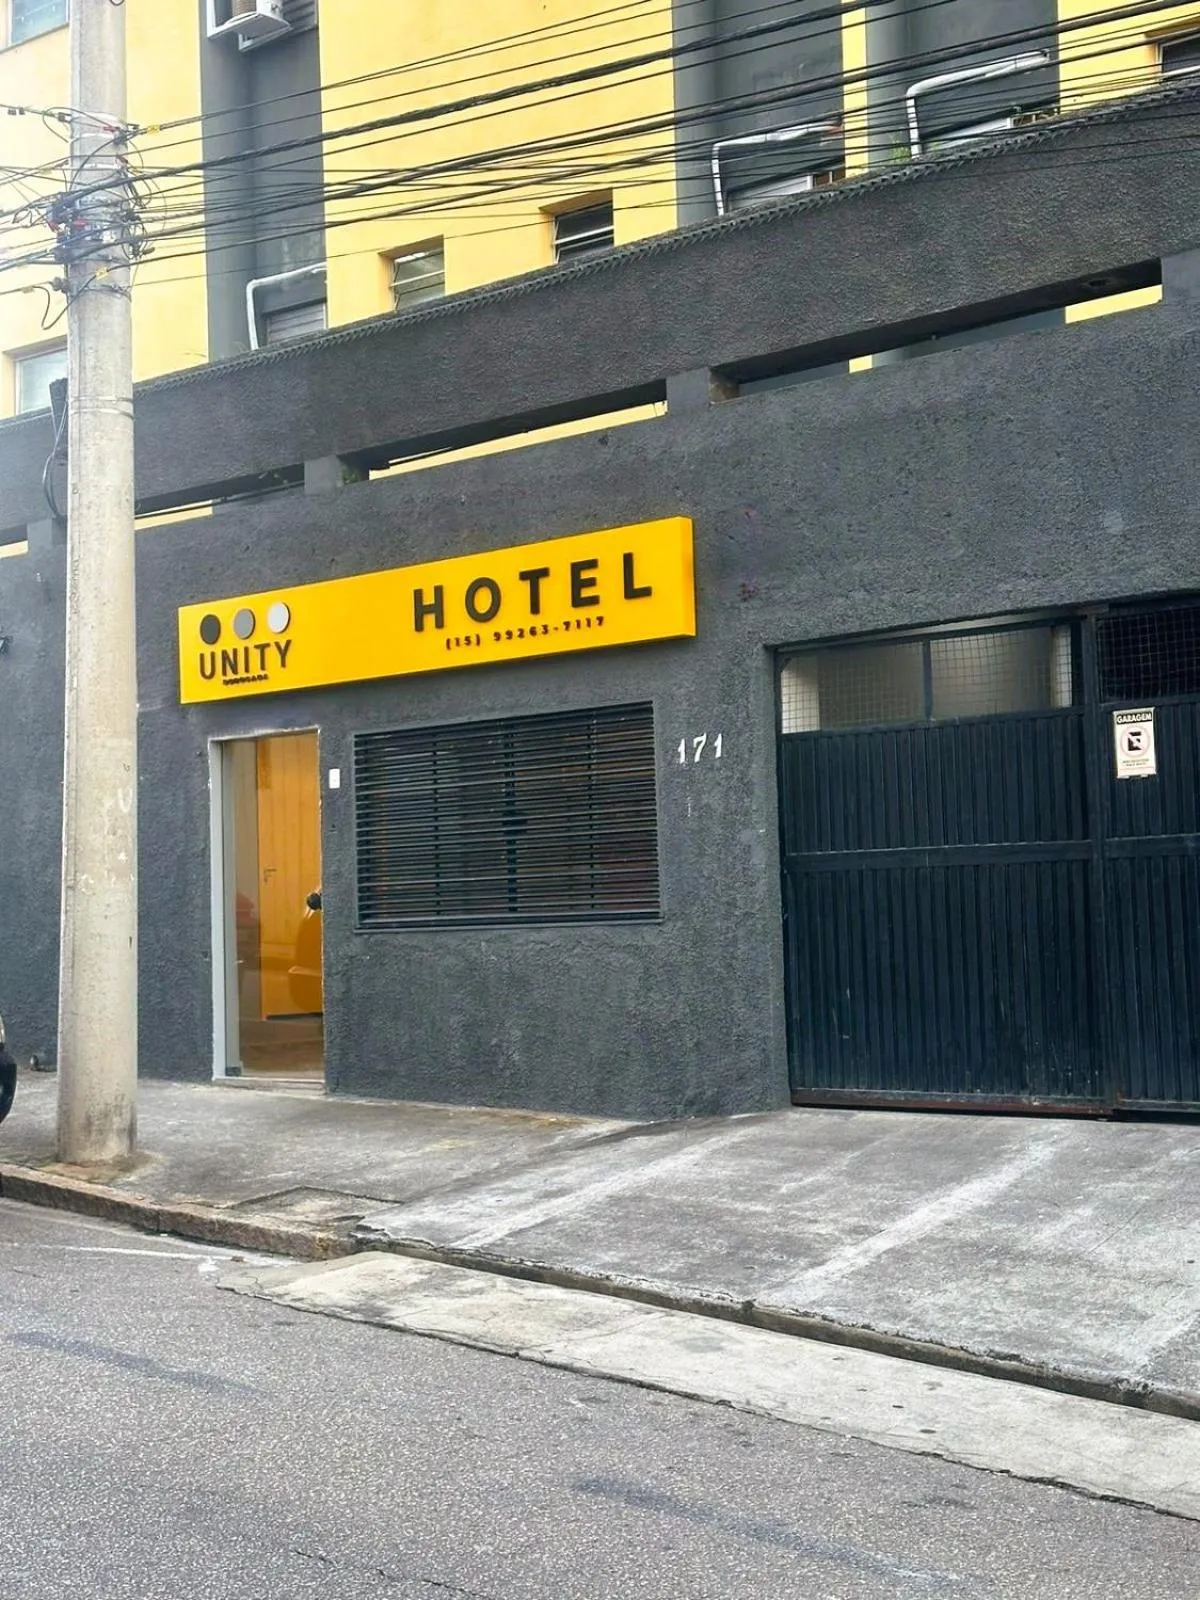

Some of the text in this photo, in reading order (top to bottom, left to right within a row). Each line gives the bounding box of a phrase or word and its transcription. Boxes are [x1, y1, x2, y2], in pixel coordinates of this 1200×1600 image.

[413, 552, 652, 632] HOTEL
[446, 616, 604, 651] (15) 99263-7117
[199, 639, 292, 680] UNITY
[1117, 712, 1152, 723] GARAGEM
[678, 732, 723, 764] 171
